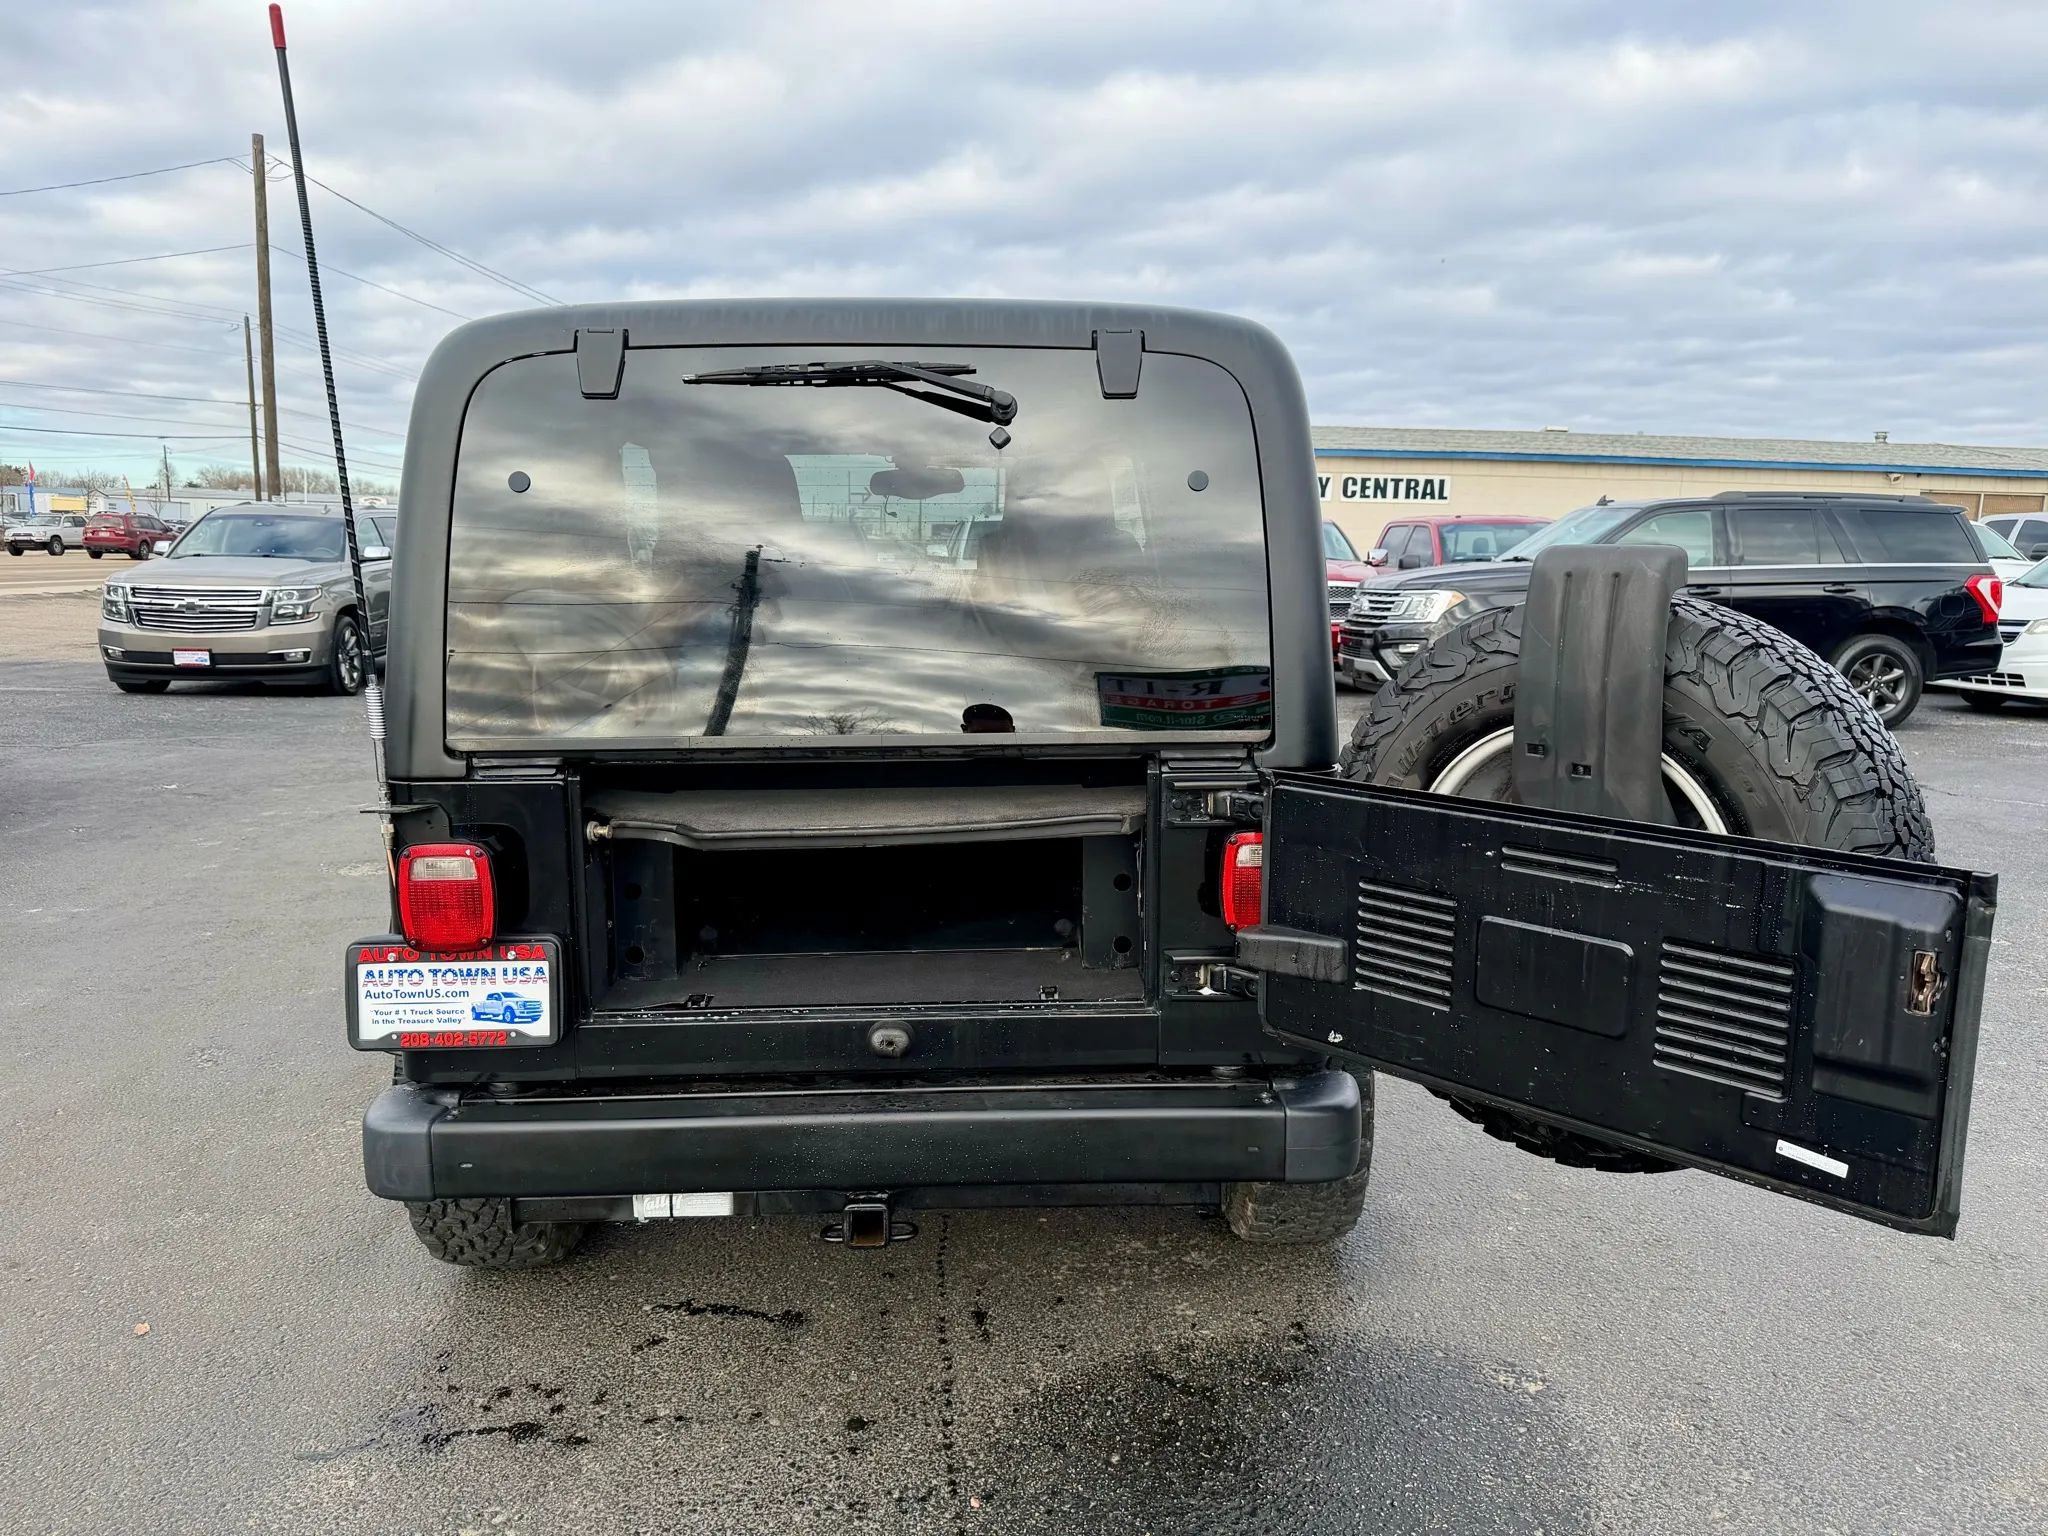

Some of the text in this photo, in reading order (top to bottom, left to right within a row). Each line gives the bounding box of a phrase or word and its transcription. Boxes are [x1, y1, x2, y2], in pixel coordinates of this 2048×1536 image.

[1342, 476, 1448, 500] CENTRAL
[358, 946, 420, 962] AUTO
[499, 944, 547, 960] USA
[362, 966, 549, 988] AUTO TOWN USA
[364, 989, 470, 1000] AutoTownUS.com
[398, 1017, 434, 1025] Treasure
[400, 1030, 508, 1048] 208-402-5772
